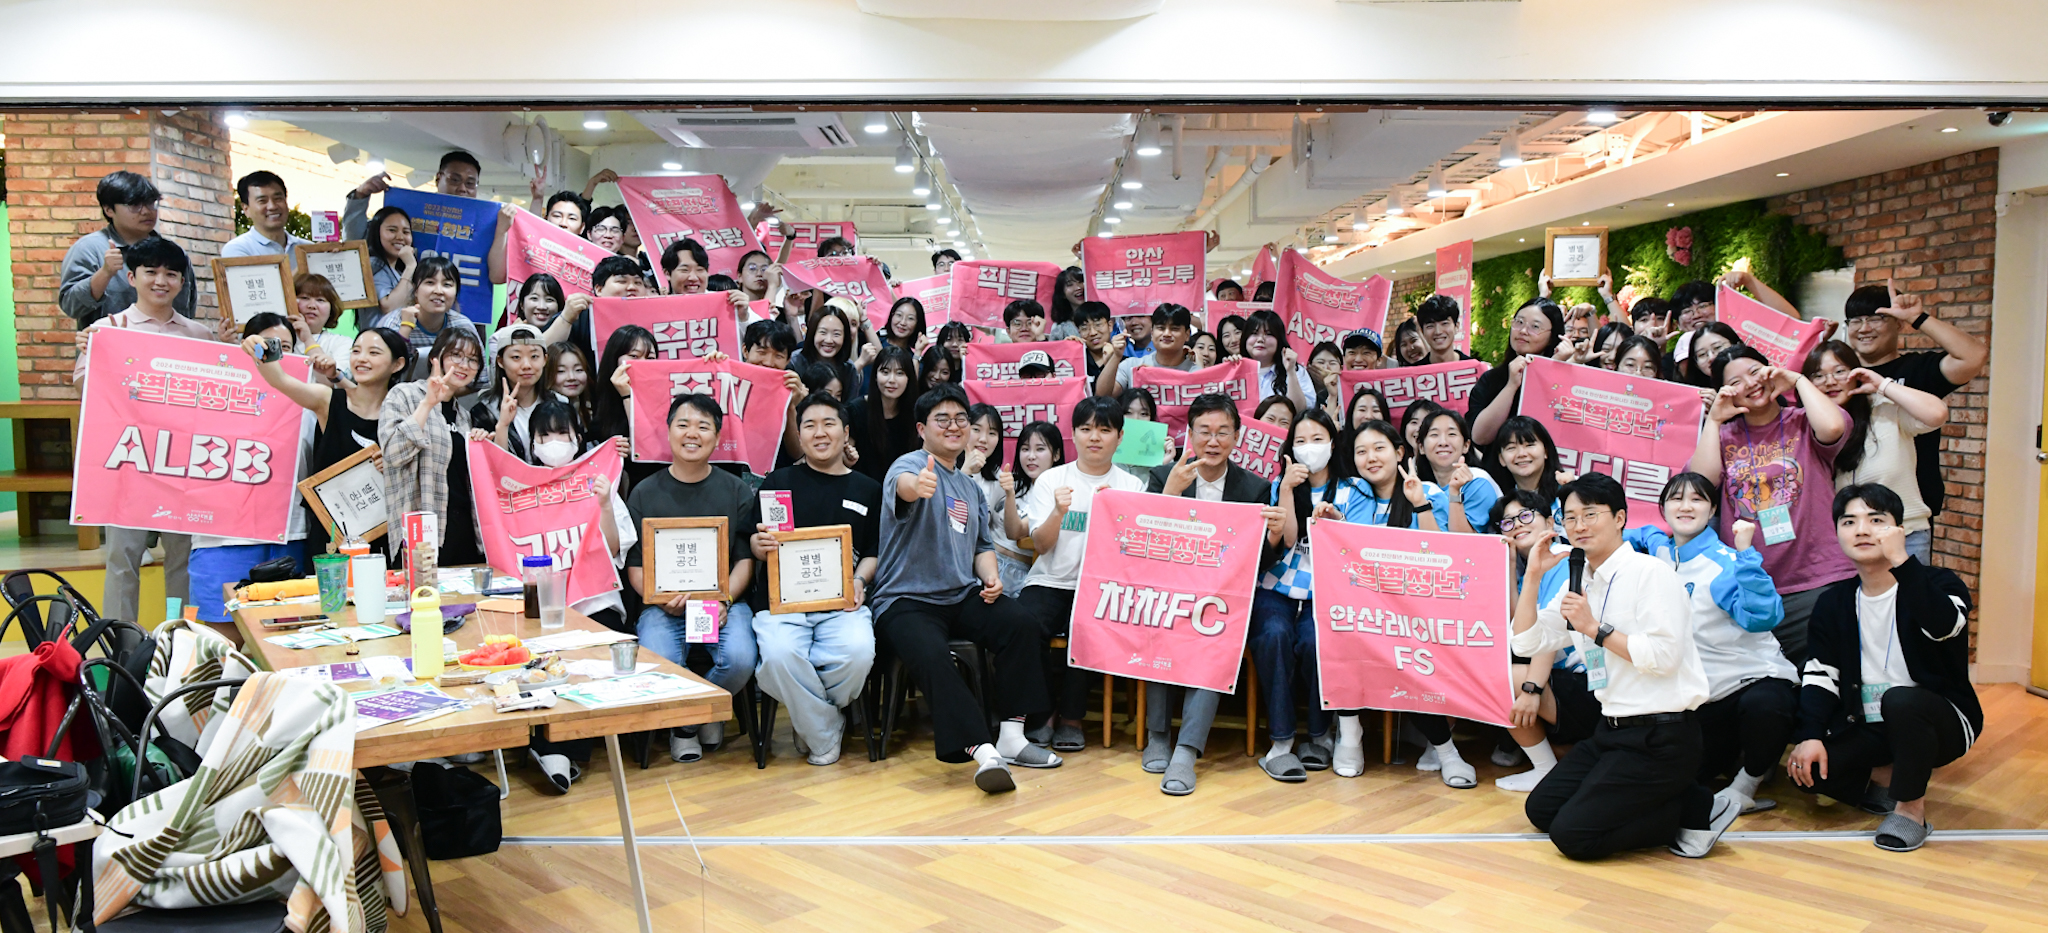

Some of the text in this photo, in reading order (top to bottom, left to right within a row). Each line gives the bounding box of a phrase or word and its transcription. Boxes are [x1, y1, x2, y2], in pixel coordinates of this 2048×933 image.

[1125, 246, 1164, 268] 안산
[325, 262, 344, 273] 별별
[245, 277, 265, 290] 별별
[328, 274, 347, 284] 공간
[1094, 263, 1196, 290] 플로깅 크루
[247, 289, 268, 301] 공간
[155, 361, 174, 369] 2024
[136, 371, 262, 417] 별별청년
[1559, 396, 1660, 440] 별별청년
[104, 425, 273, 485] ALBB
[503, 479, 519, 490] 2024
[1760, 508, 1786, 519] STAFF
[1138, 517, 1154, 525] 2024
[675, 542, 698, 555] 별별
[1125, 527, 1224, 568] 별별청년
[675, 556, 698, 568] 공간
[799, 552, 822, 566] 별별
[800, 565, 823, 579] 공간
[1350, 561, 1464, 600] 별별청년
[1093, 580, 1229, 636] 차차FC
[1329, 604, 1495, 647] 안산레이디스
[1393, 645, 1436, 677] FS
[1861, 683, 1892, 694] STAFF
